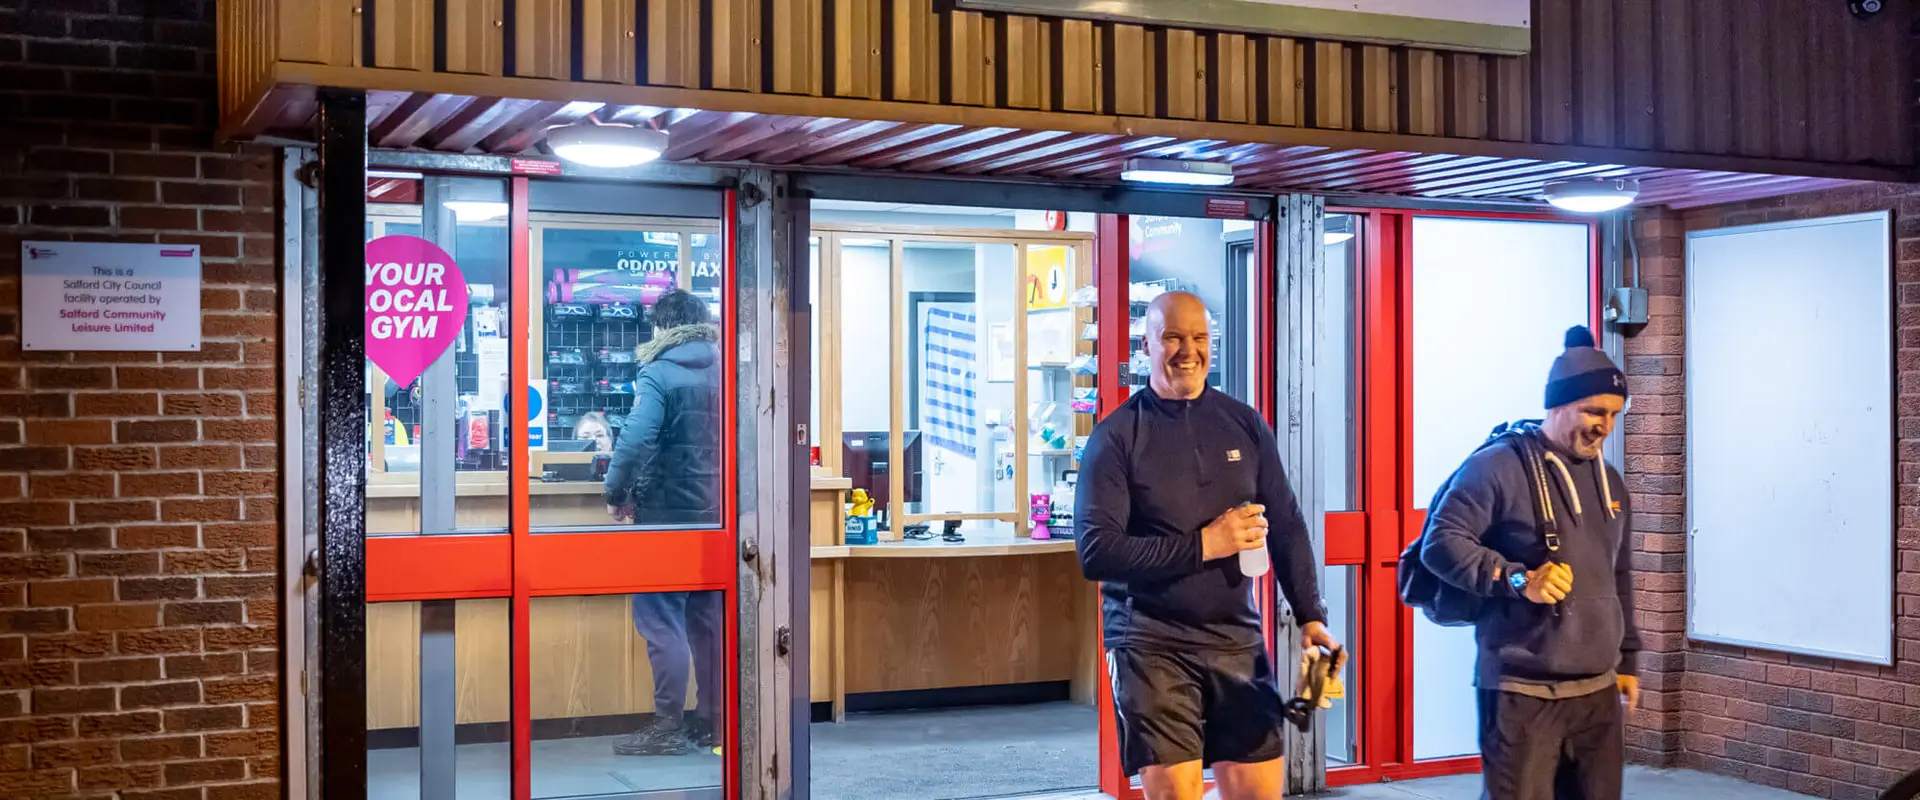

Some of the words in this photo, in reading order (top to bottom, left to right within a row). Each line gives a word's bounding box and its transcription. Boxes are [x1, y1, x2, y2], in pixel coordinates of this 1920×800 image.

[92, 266, 113, 277] This
[115, 266, 124, 277] is
[126, 268, 134, 277] a
[366, 262, 446, 286] YOUR
[617, 258, 720, 277] SPORTAX
[63, 279, 100, 290] Salford
[102, 280, 121, 291] City
[124, 280, 162, 290] Council
[64, 293, 97, 304] facility
[99, 293, 146, 305] operated
[149, 294, 162, 306] by
[366, 289, 454, 313] OCAL
[59, 309, 100, 319] Salford
[103, 309, 166, 322] Community
[71, 322, 112, 333] Leisure
[114, 323, 155, 333] Limited
[371, 315, 439, 340] GYM
